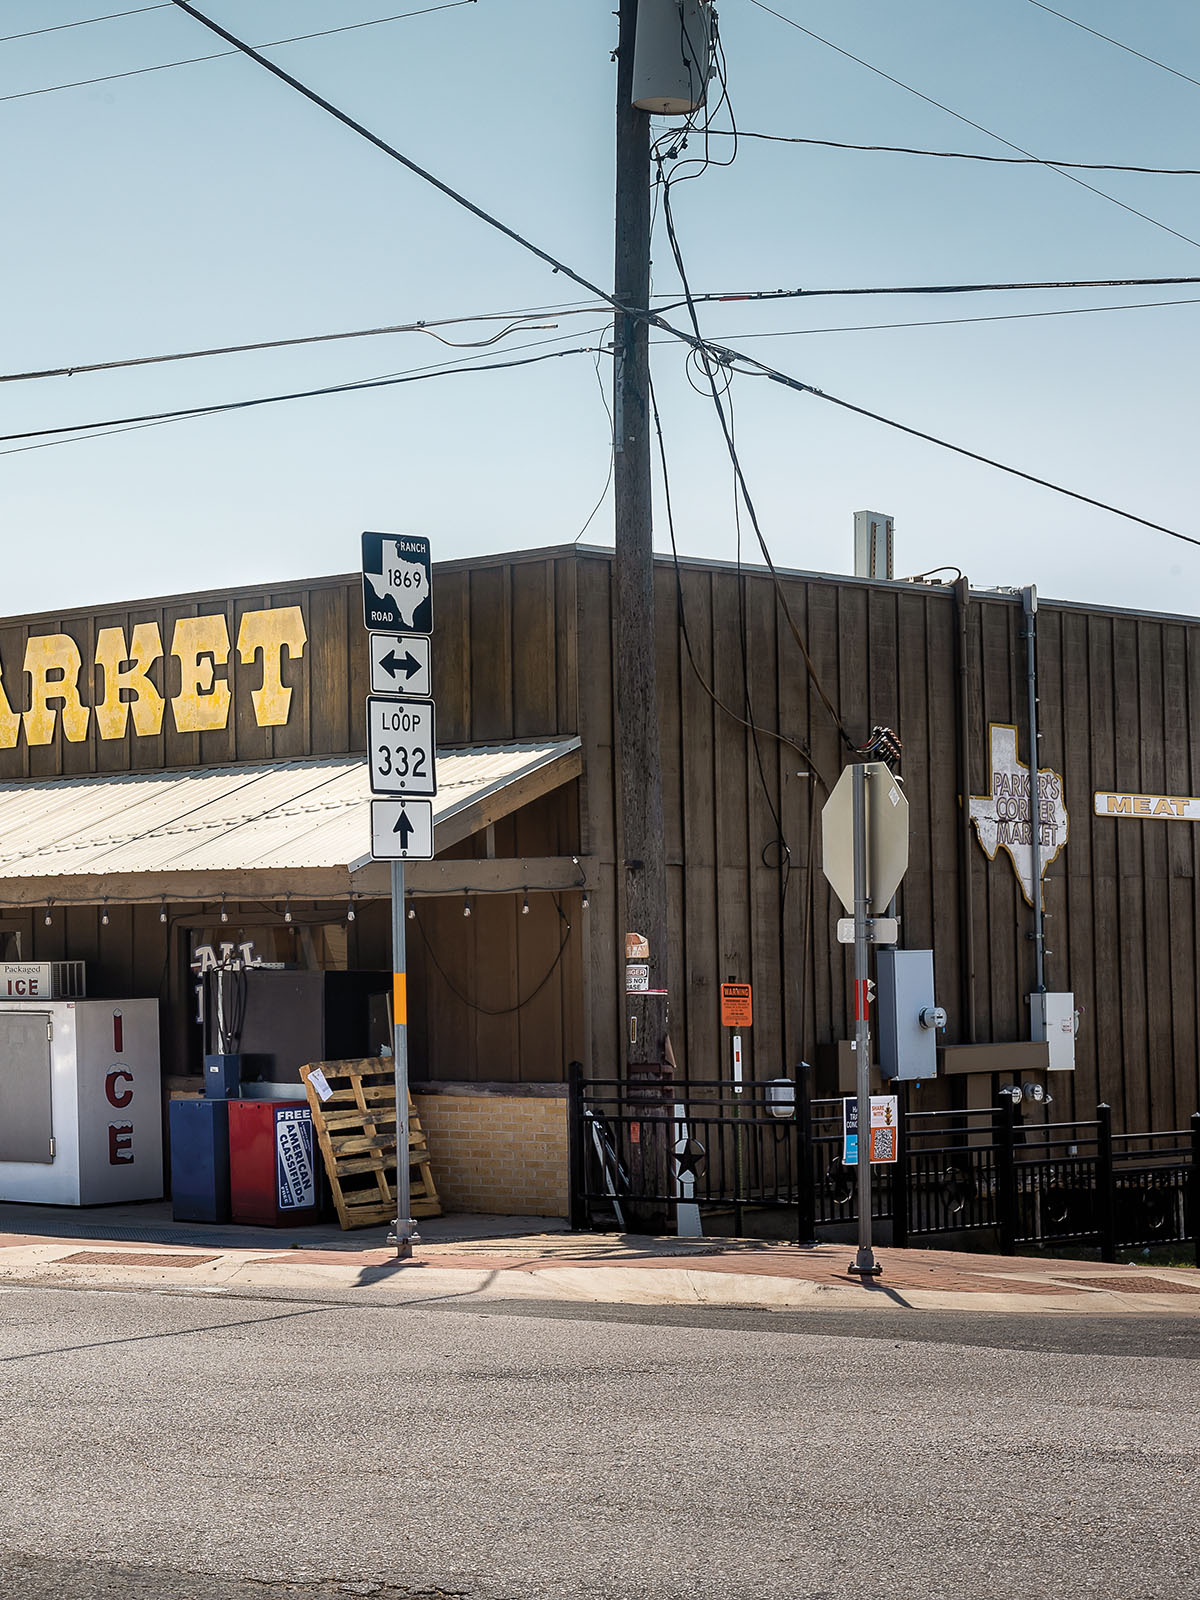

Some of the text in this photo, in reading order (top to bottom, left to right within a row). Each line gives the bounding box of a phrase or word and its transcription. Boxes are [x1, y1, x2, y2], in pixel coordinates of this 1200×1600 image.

[400, 541, 426, 553] RANCH
[388, 568, 421, 588] 1869
[371, 610, 393, 622] ROAD
[382, 712, 421, 732] LOOP
[378, 745, 427, 777] 332
[993, 772, 1060, 800] PARKR'S
[996, 797, 1057, 823] CORER
[1106, 796, 1190, 816] MEAT
[996, 821, 1059, 846] MARET
[195, 942, 262, 972] ALL
[4, 965, 41, 974] Packaged
[7, 978, 39, 996] ICE
[104, 1007, 135, 1166] ICE
[277, 1110, 311, 1120] FREE
[280, 1134, 305, 1203] CLASSIFIEDS
[287, 1124, 312, 1191] AMERICAN
